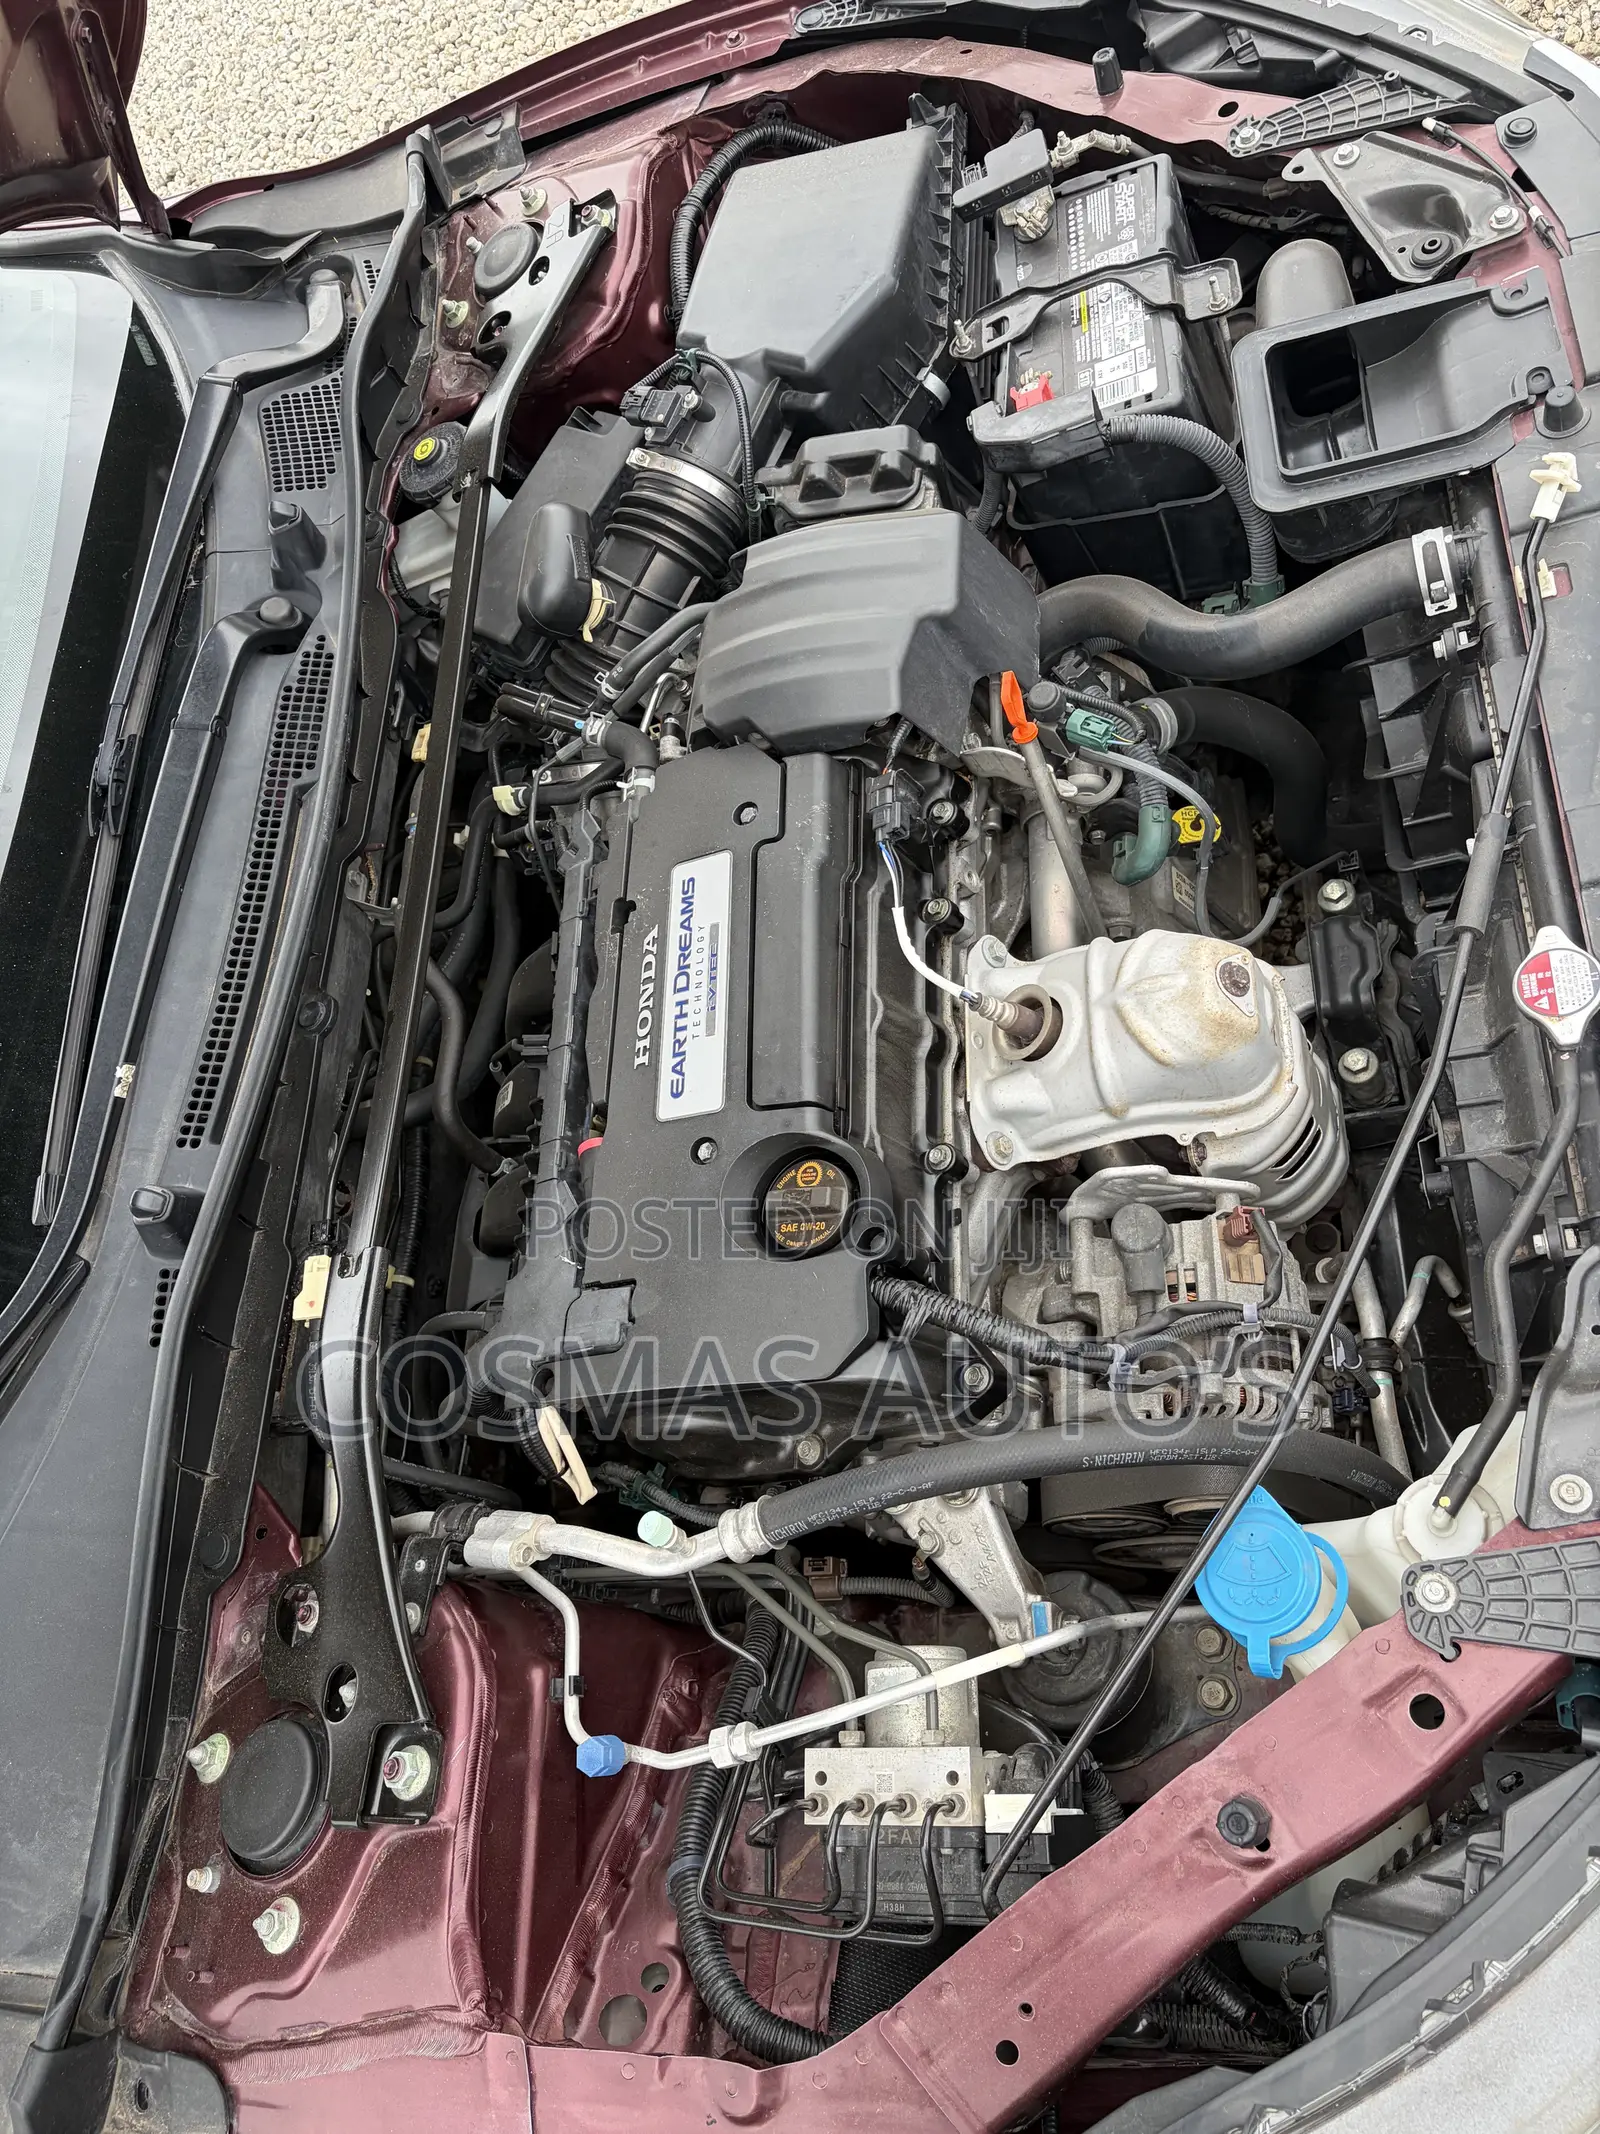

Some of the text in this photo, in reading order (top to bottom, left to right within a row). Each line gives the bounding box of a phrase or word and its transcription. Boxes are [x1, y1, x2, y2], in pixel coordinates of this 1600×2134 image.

[1115, 181, 1126, 226] START
[1124, 182, 1136, 226] SUPER
[670, 876, 696, 1100] EARTH DREAMS
[692, 924, 705, 1040] TECHNOLOGY
[1521, 973, 1531, 999] DANGER
[634, 923, 659, 1070] HONDA
[776, 1168, 837, 1190] ENGINE OIL
[780, 1221, 826, 1233] SAE 0W-20
[810, 1229, 832, 1244] MANUAL
[766, 1520, 809, 1543] NICHIRIN
[883, 1903, 905, 1912] H38H
